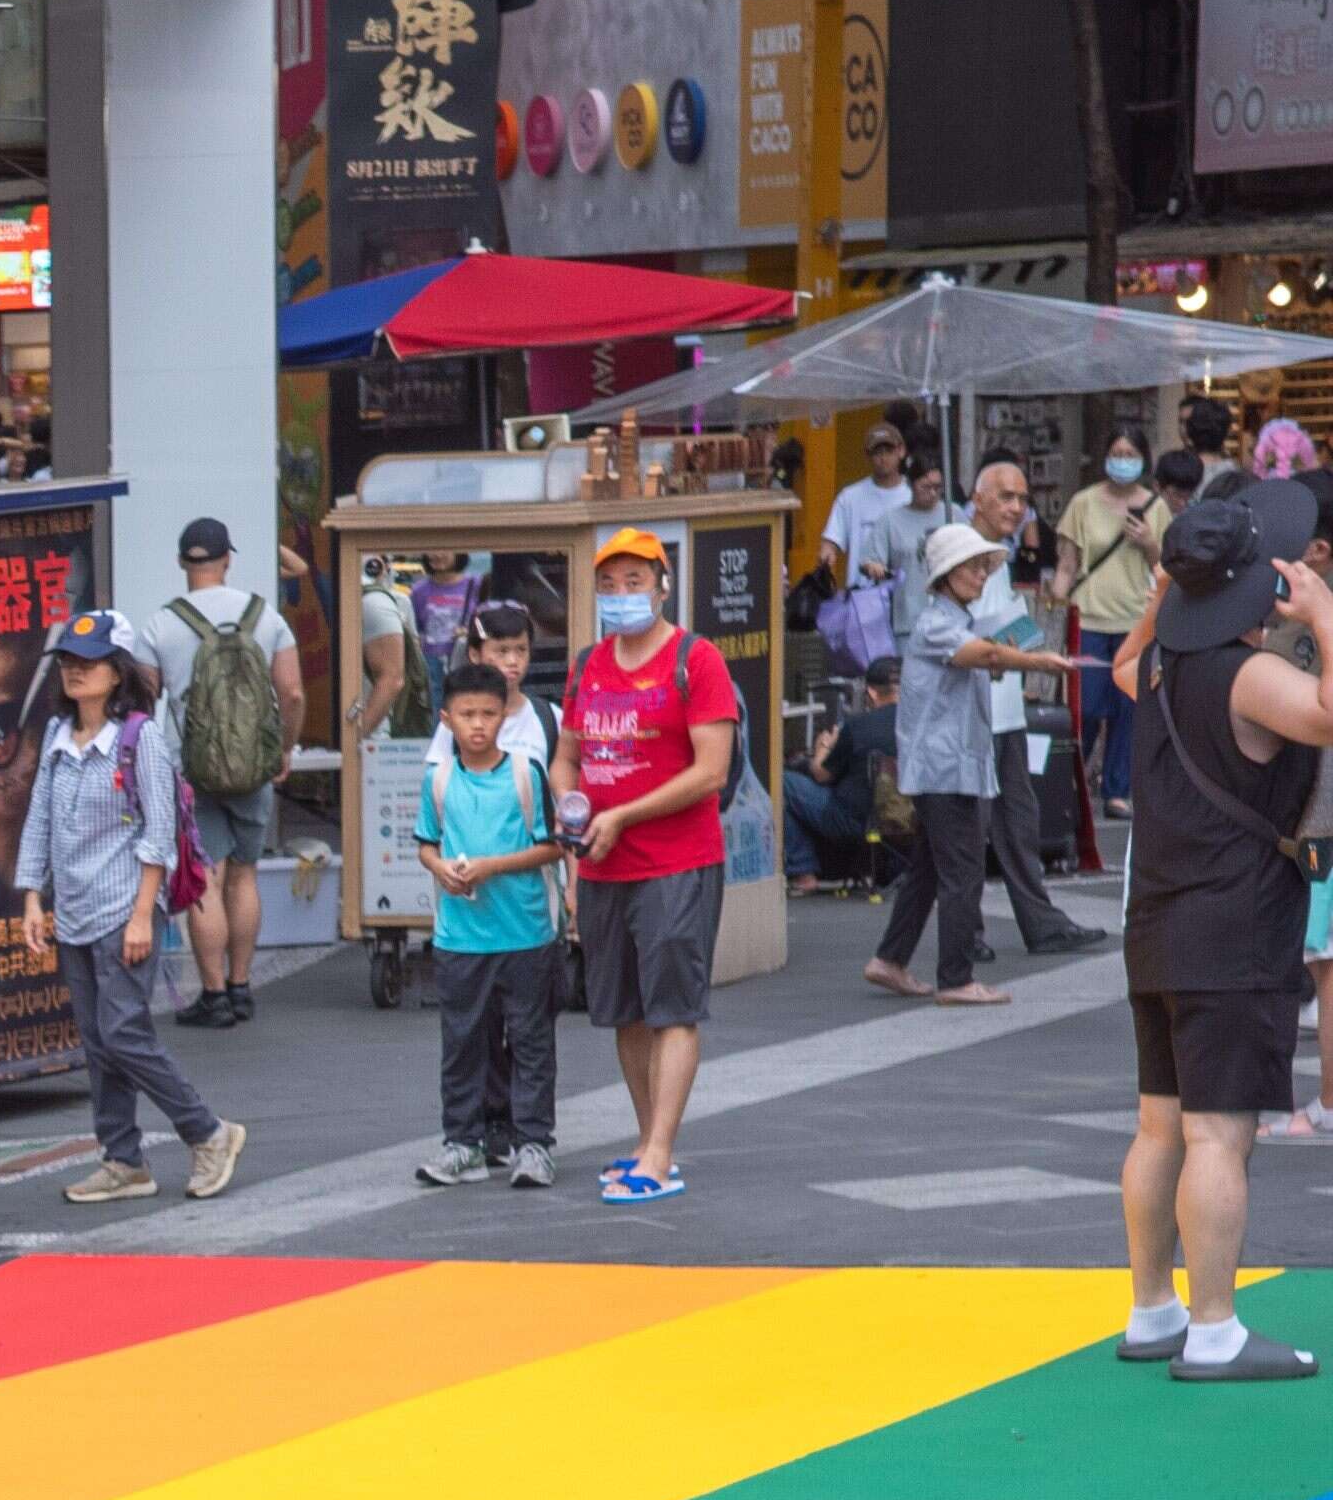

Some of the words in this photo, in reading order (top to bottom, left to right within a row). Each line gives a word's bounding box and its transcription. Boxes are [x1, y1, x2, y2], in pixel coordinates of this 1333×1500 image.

[751, 59, 779, 90] FUN
[749, 122, 792, 156] CACO
[345, 157, 410, 180] 8月21日
[719, 548, 749, 575] STOP
